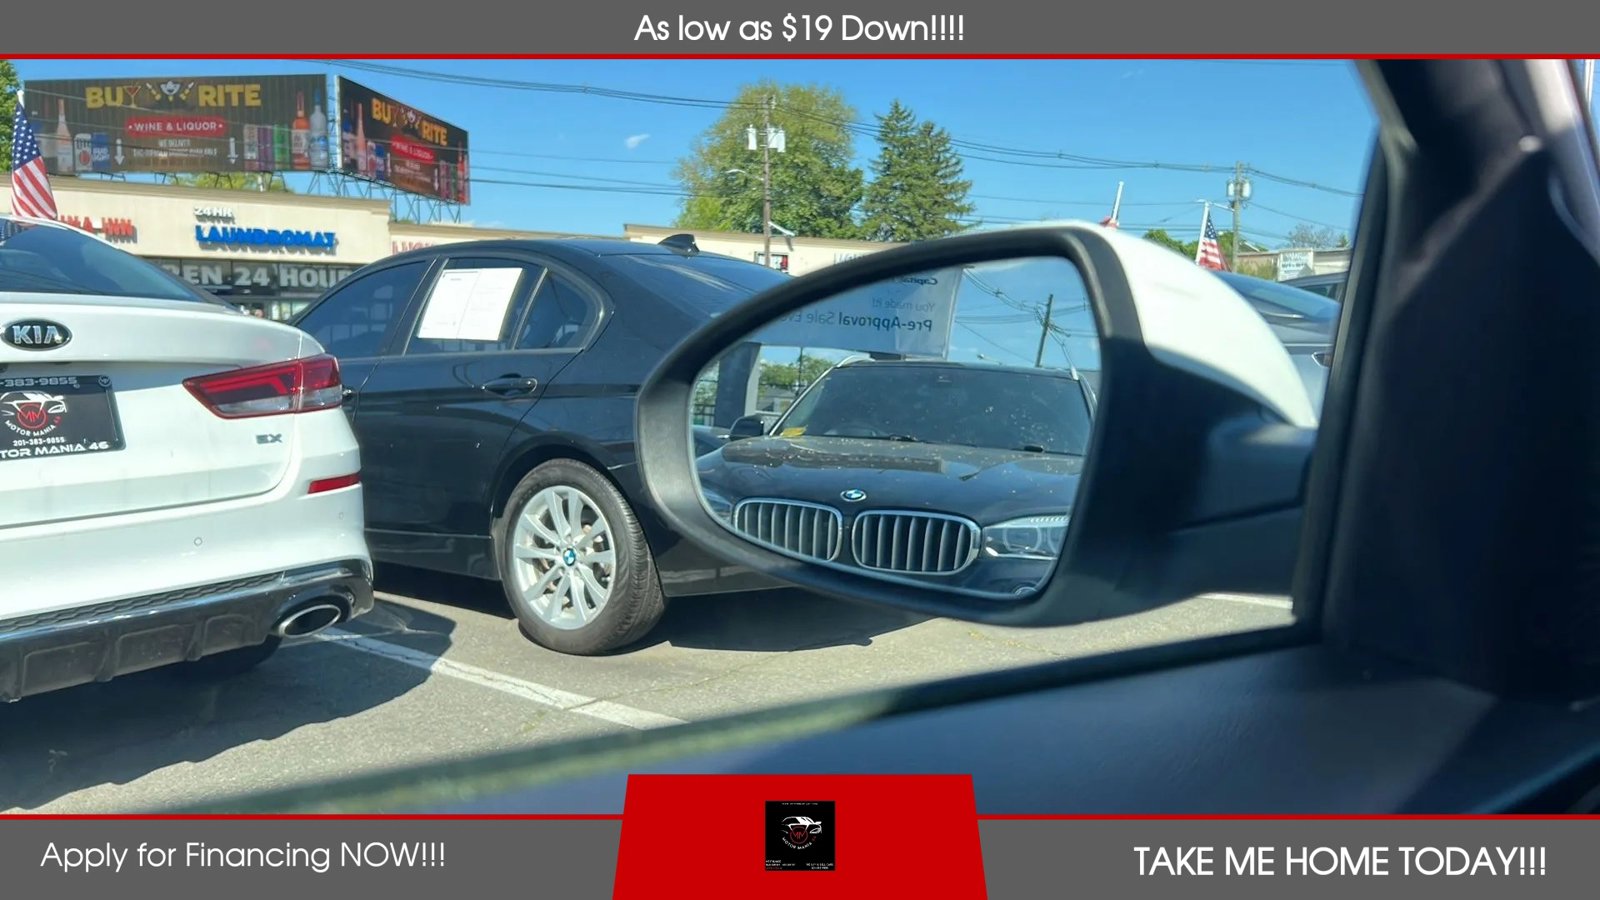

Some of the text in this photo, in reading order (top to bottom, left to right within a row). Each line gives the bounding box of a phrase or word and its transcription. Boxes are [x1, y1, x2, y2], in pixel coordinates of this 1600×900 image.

[198, 84, 261, 107] RITE
[134, 121, 217, 131] WINE & LIQUOR
[422, 121, 448, 146] RITE
[195, 207, 233, 217] 24 HR
[195, 225, 336, 248] LAUNDROMAT
[234, 266, 270, 286] 24
[12, 325, 63, 344] KIA
[5, 420, 31, 437] MOTOR
[33, 424, 56, 437] MANIA
[256, 433, 283, 444] EX
[34, 443, 87, 456] MANIA
[88, 441, 109, 451] 46
